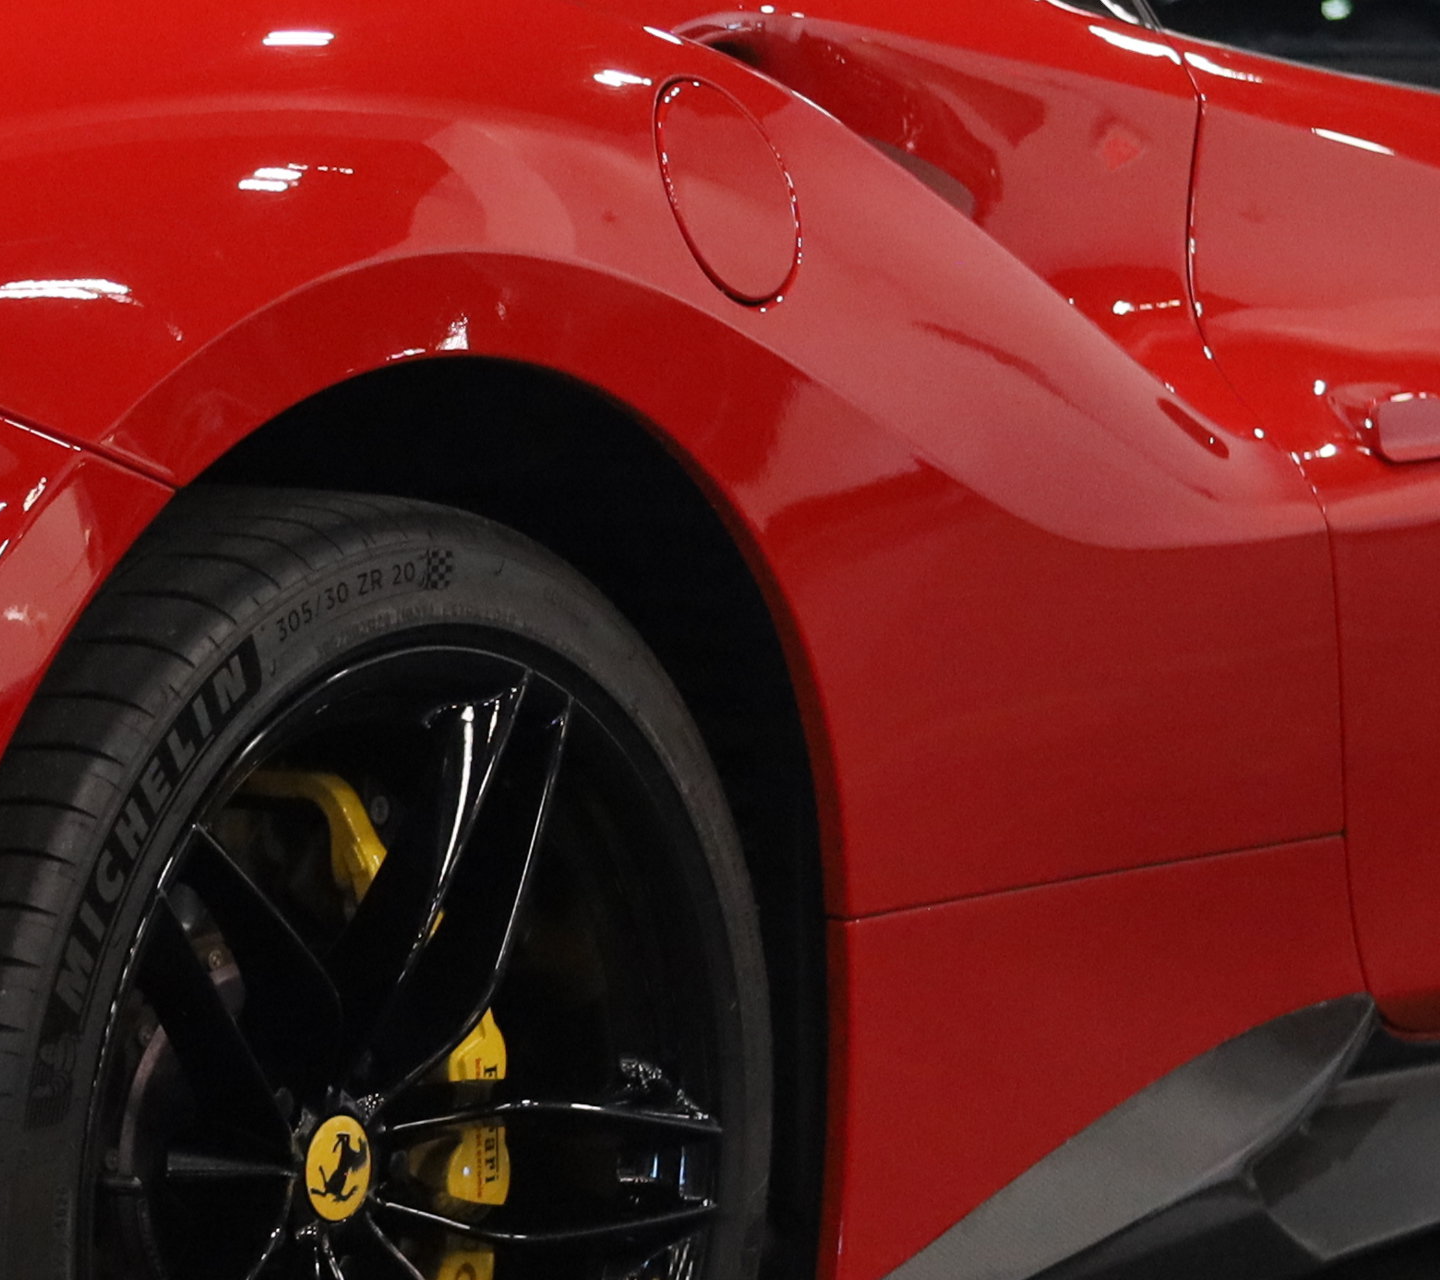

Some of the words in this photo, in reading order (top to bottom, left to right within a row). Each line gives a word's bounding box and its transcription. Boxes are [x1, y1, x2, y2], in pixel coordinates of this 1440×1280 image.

[276, 583, 349, 642] 305/30
[357, 570, 383, 596] ZR
[392, 562, 416, 586] 20
[54, 653, 249, 1016] MICHELIN
[483, 1063, 499, 1184] Fari
